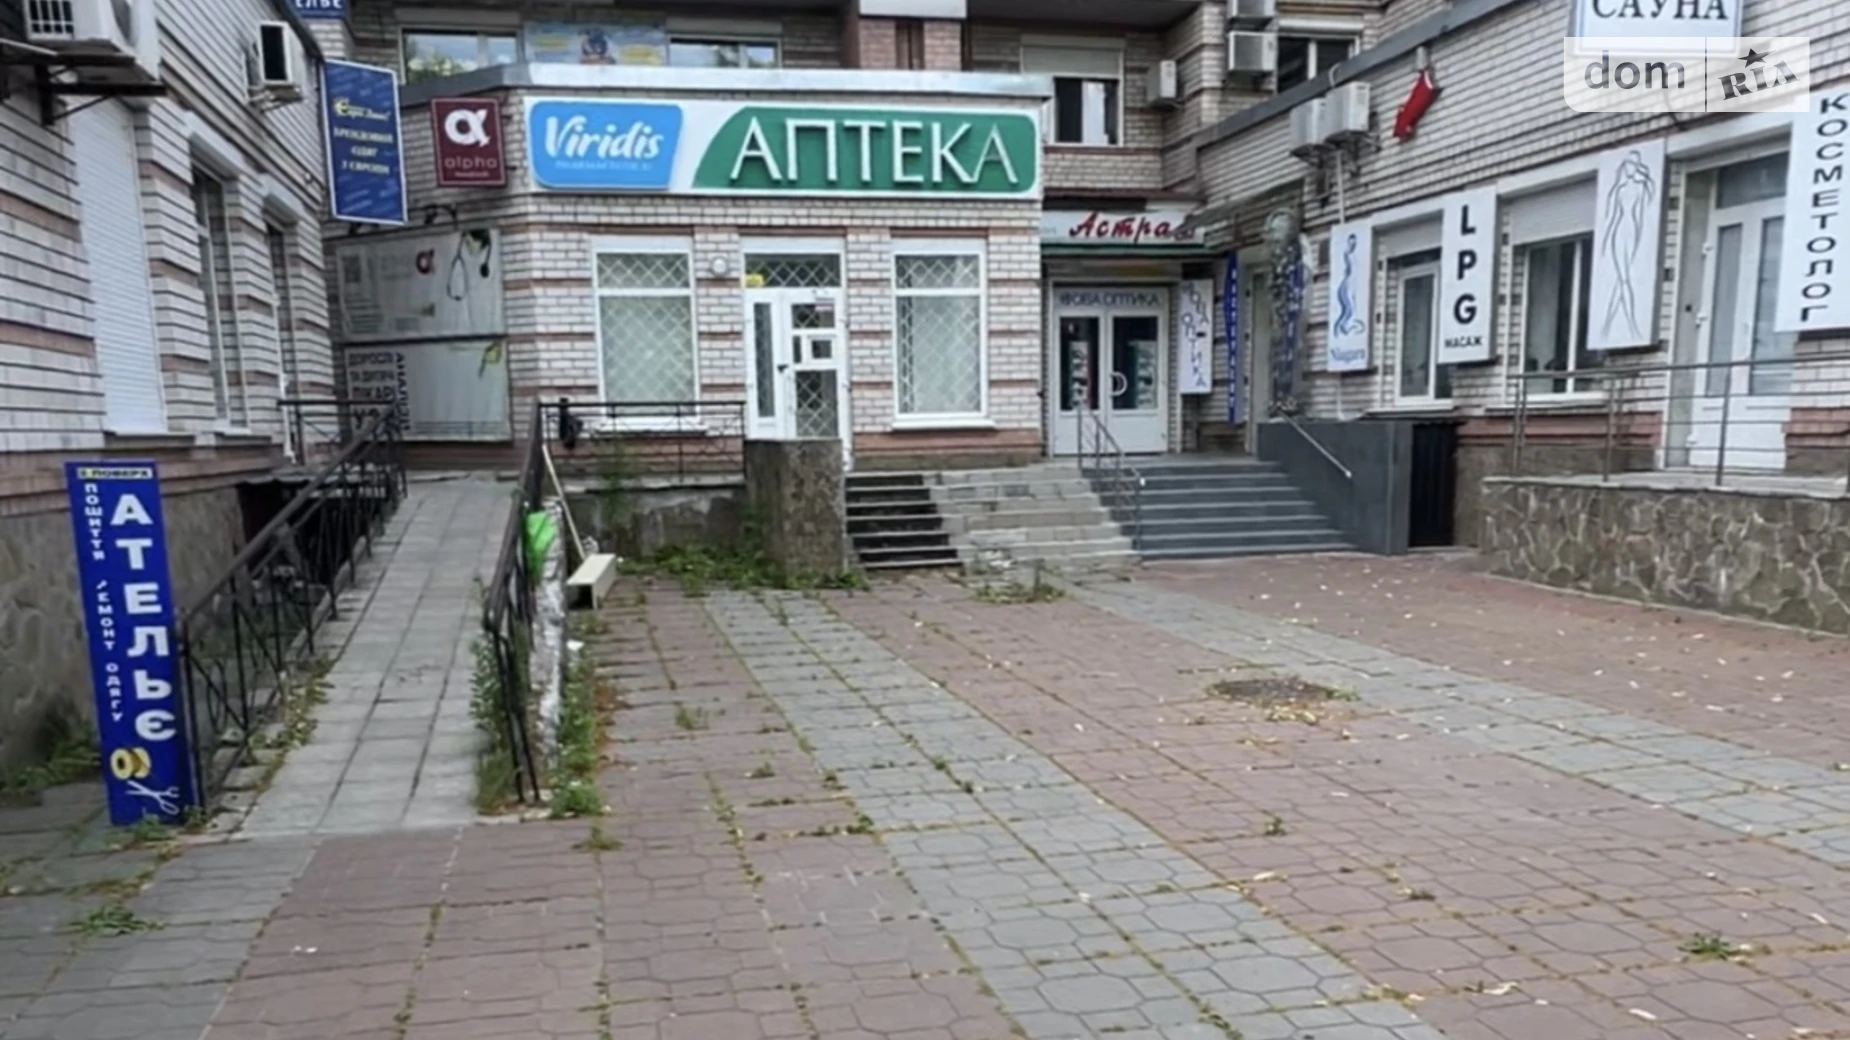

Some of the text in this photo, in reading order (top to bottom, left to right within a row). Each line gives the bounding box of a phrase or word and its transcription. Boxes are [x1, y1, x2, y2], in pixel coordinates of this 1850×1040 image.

[1592, 0, 1729, 20] САУНА
[445, 155, 498, 169] alpha
[545, 115, 664, 159] Viridis
[730, 116, 1018, 184] АПТЕКА
[1069, 210, 1171, 244] Астра
[1801, 93, 1849, 322] КОСМЕТОЛОГ
[1454, 205, 1477, 324] LPG
[1103, 292, 1159, 305] ОПТИКА
[84, 483, 105, 561] ПОШИТТЯ
[111, 494, 177, 741] АТЕЛЬЄ
[105, 663, 123, 722] ОДЯГУ
